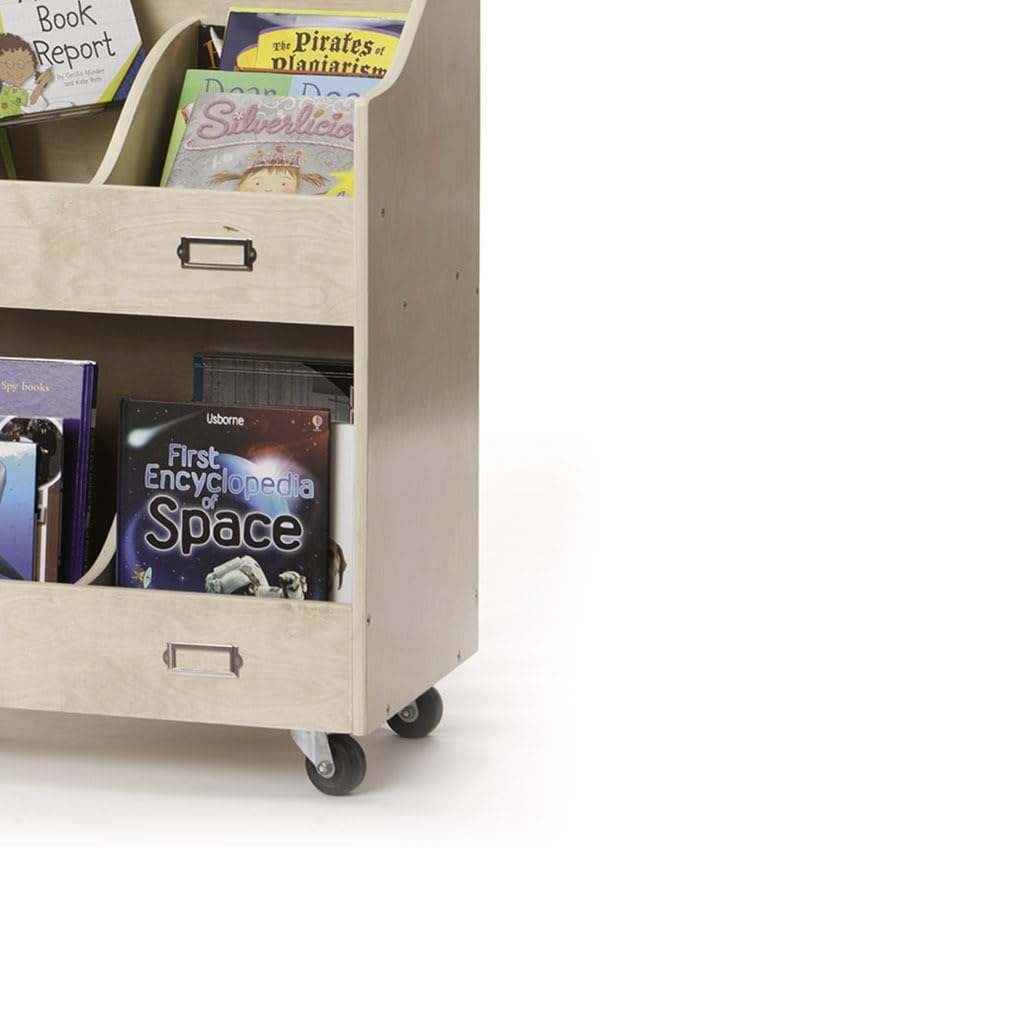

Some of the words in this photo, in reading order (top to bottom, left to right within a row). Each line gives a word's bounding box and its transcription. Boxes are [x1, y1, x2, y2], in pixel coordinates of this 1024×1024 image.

[37, 1, 97, 32] Book
[33, 31, 116, 69] Report
[273, 40, 291, 51] The
[292, 30, 374, 57] Pirates
[375, 46, 385, 56] of
[197, 99, 354, 141] Silverlicio
[1, 380, 18, 392] Spy
[22, 381, 49, 392] books
[206, 413, 244, 426] Usborne
[168, 443, 220, 470] First
[144, 463, 315, 500] Encyclopedia
[202, 494, 219, 509] of
[144, 495, 303, 555] Space
